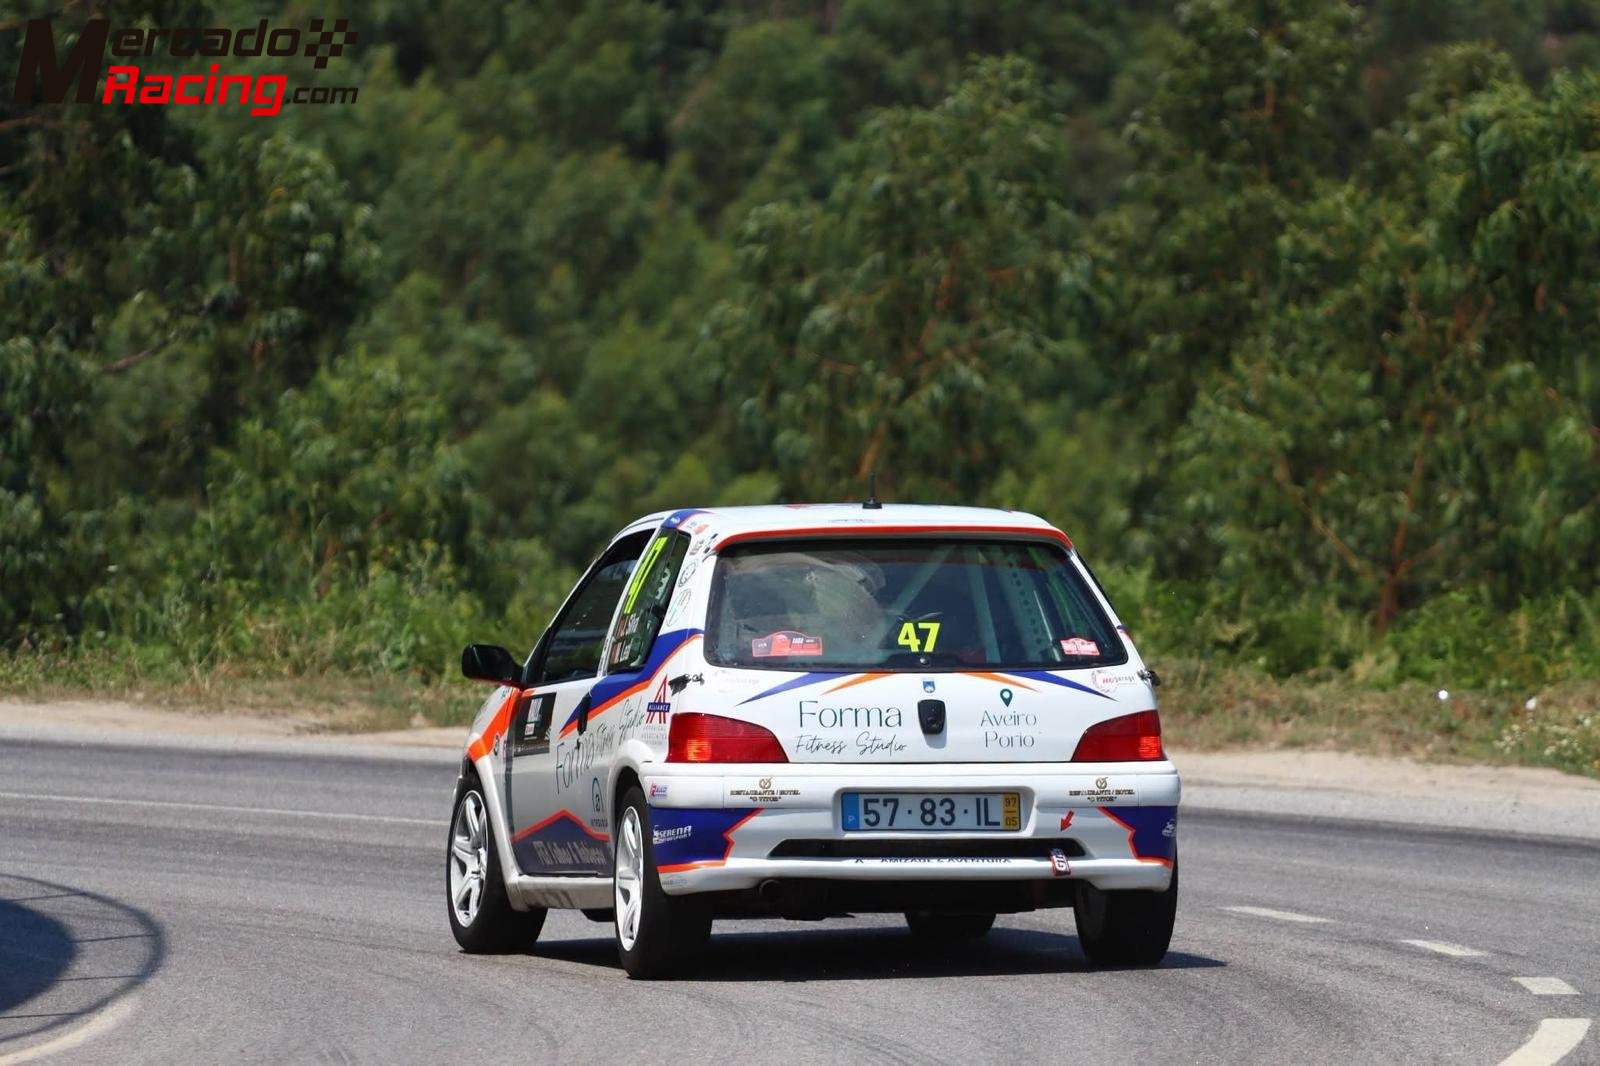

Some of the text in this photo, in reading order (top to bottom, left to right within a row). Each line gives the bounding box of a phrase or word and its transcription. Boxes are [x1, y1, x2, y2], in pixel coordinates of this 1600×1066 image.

[897, 622, 940, 652] 47
[799, 700, 902, 728] Forma
[980, 710, 1037, 727] Aveiro
[795, 731, 906, 756] Fitness Studio
[847, 815, 856, 824] P
[1005, 817, 1018, 826] 05
